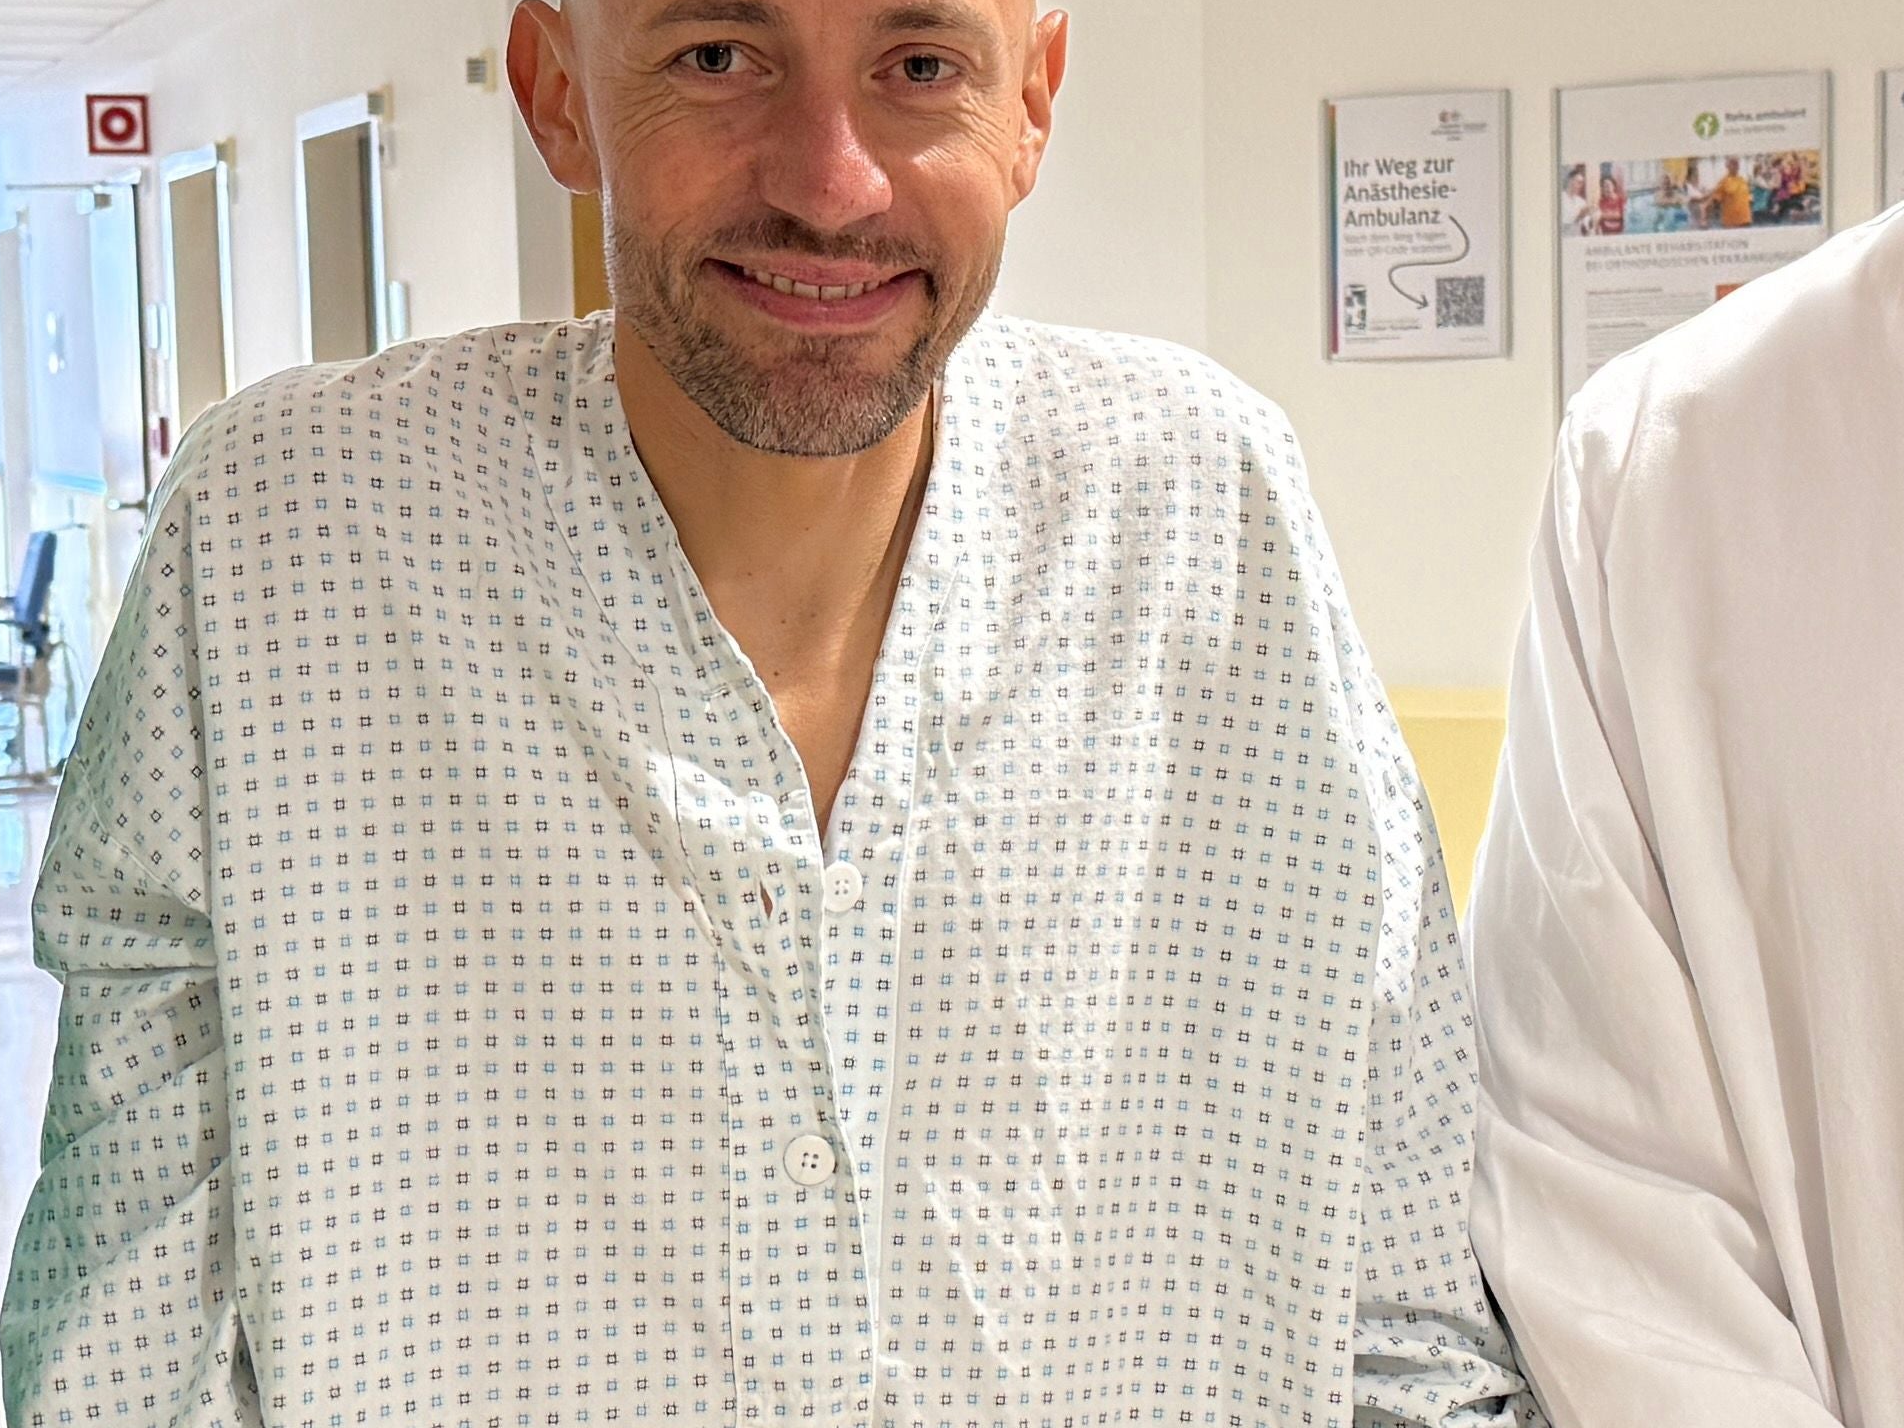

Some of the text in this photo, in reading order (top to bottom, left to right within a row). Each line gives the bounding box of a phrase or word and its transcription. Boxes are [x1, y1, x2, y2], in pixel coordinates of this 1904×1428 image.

[1344, 158, 1455, 179] Ihr Weg zur
[1344, 179, 1457, 202] Anästhesie-
[1345, 207, 1441, 227] Ambulanz
[1585, 239, 1749, 257] AMBULANTE REHABILITATION
